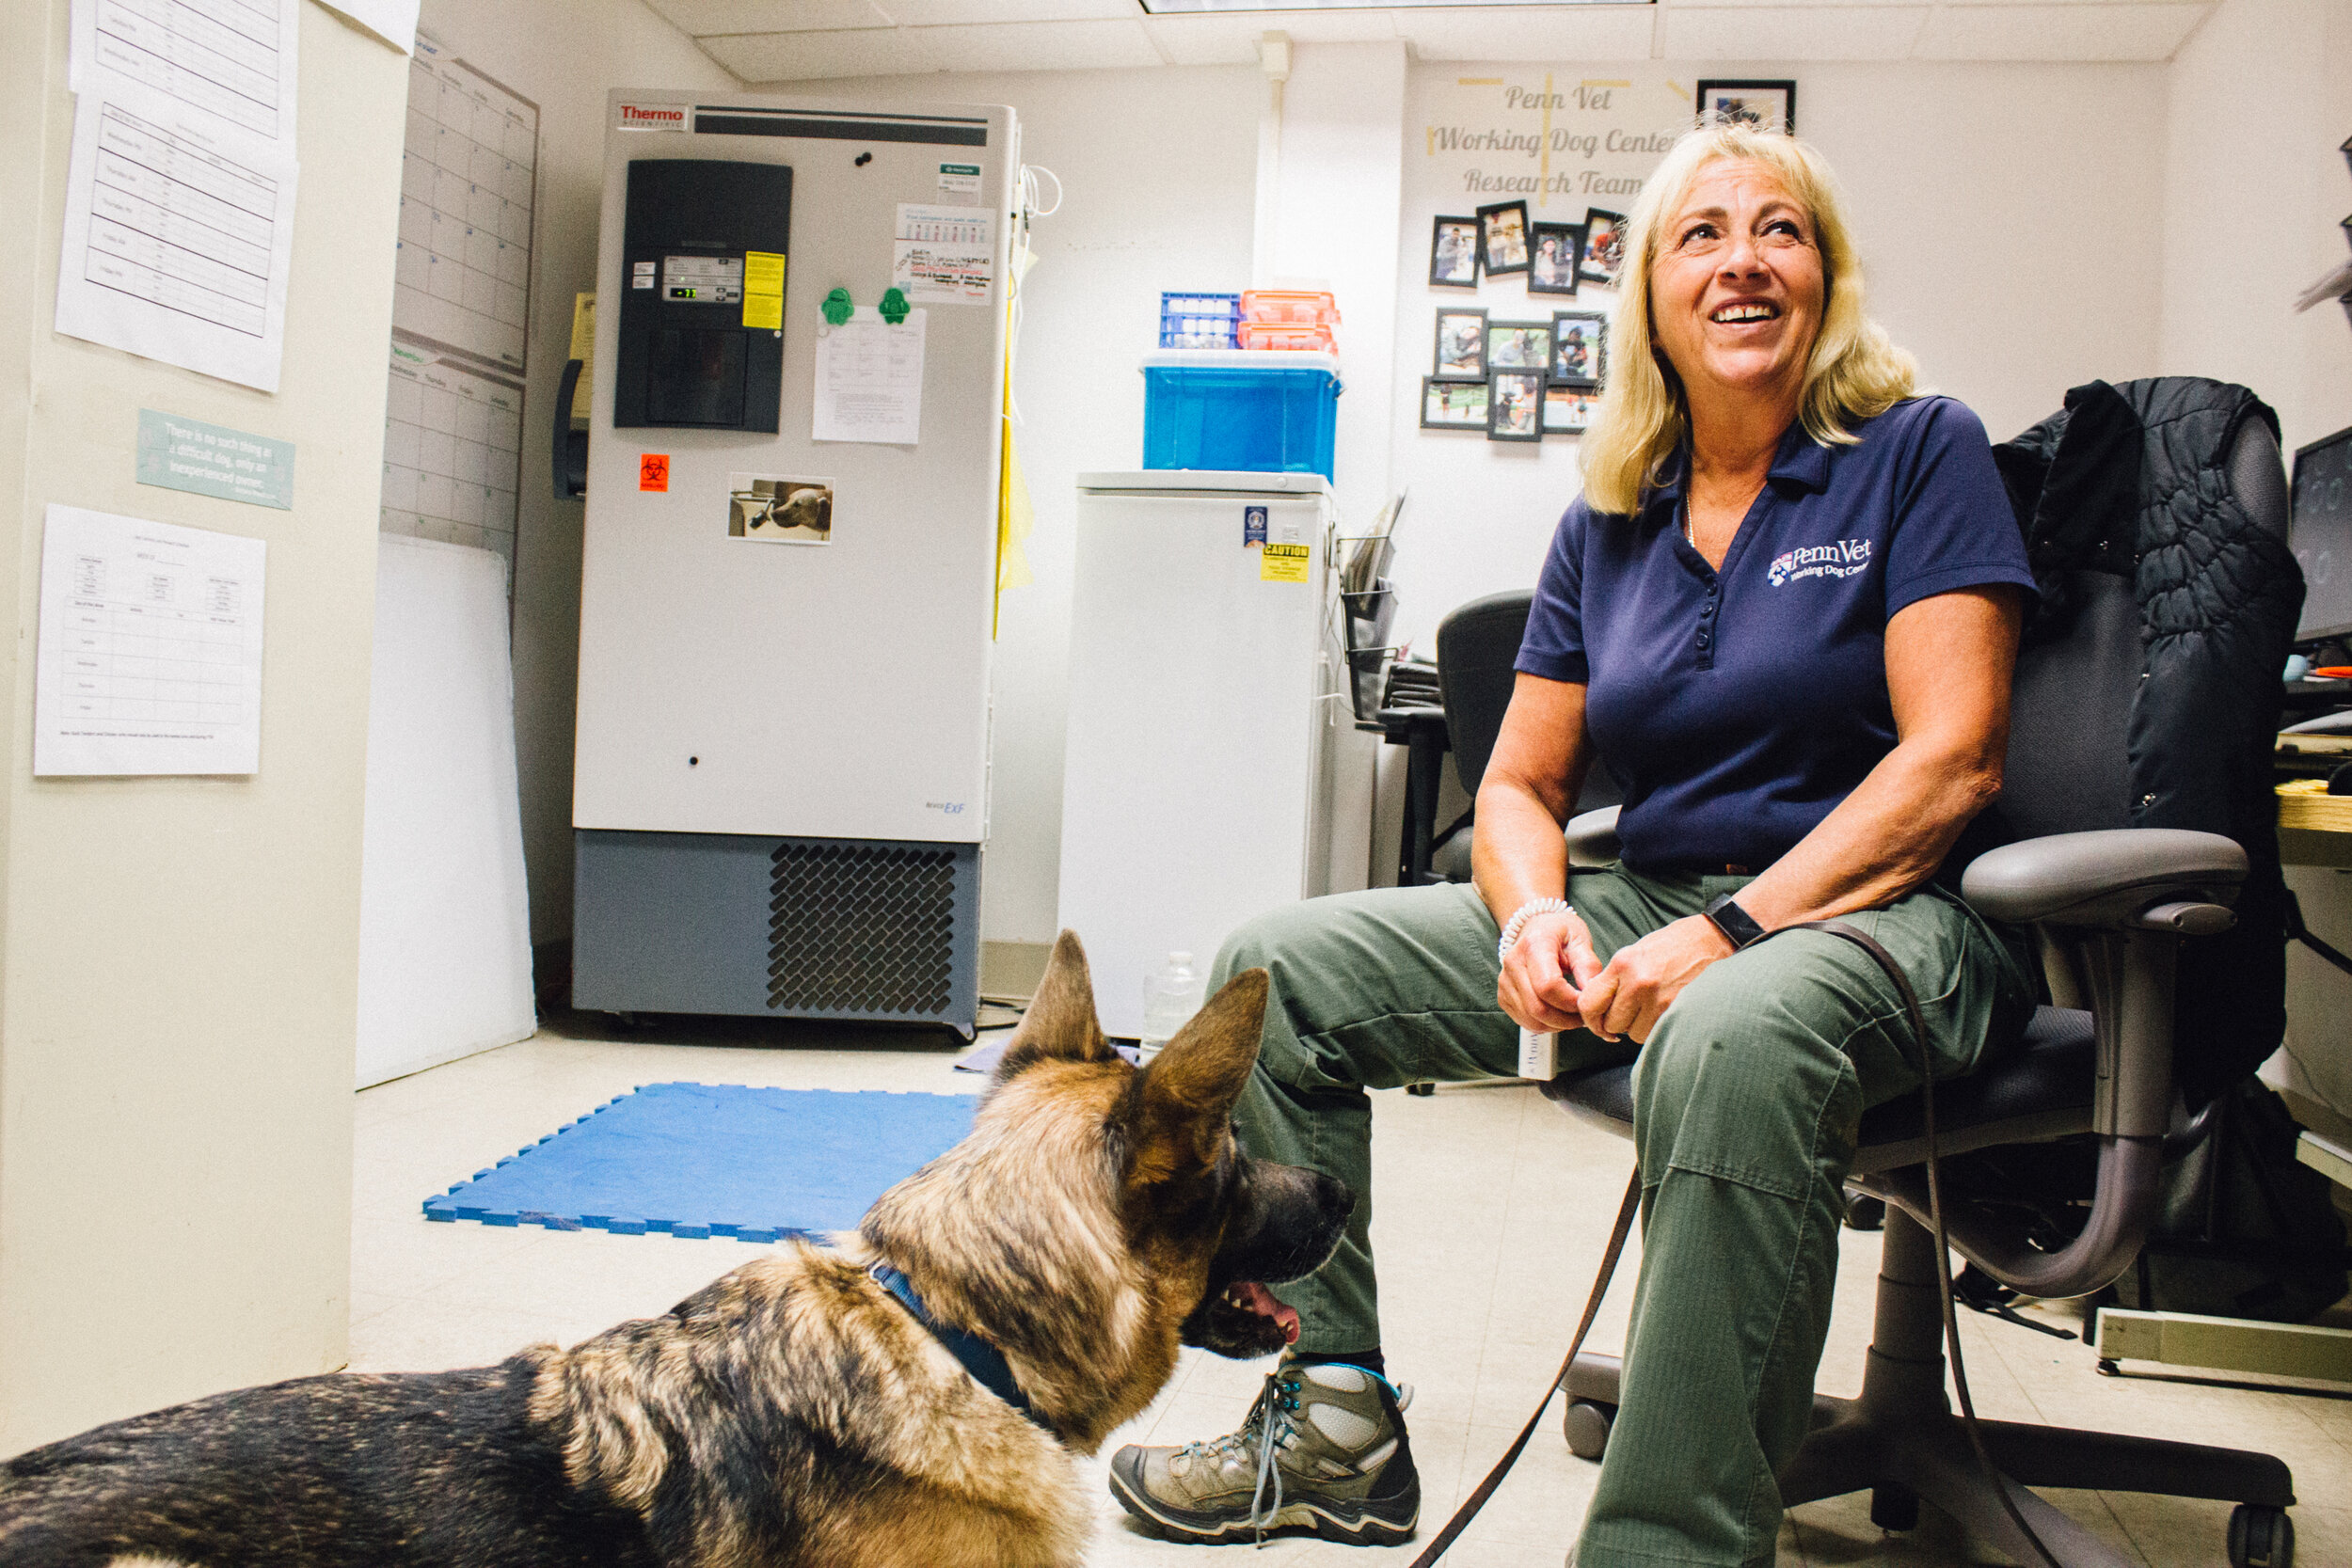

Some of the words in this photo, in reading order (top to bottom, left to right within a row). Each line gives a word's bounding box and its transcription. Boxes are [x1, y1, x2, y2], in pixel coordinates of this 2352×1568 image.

[1504, 86, 1565, 110] Penn
[1572, 87, 1612, 110] Vet
[621, 105, 684, 121] Thermo
[1432, 126, 1542, 158] Working
[1546, 128, 1598, 159] Dog
[1463, 168, 1572, 193] Research
[1577, 170, 1643, 194] Team
[166, 421, 194, 441] There
[194, 430, 202, 443] is
[203, 434, 216, 446] no
[239, 440, 262, 458] thing
[177, 443, 213, 463] difficult
[1264, 546, 1308, 557] CAUTION
[1789, 565, 1824, 581] Working
[1824, 564, 1845, 578] Dog
